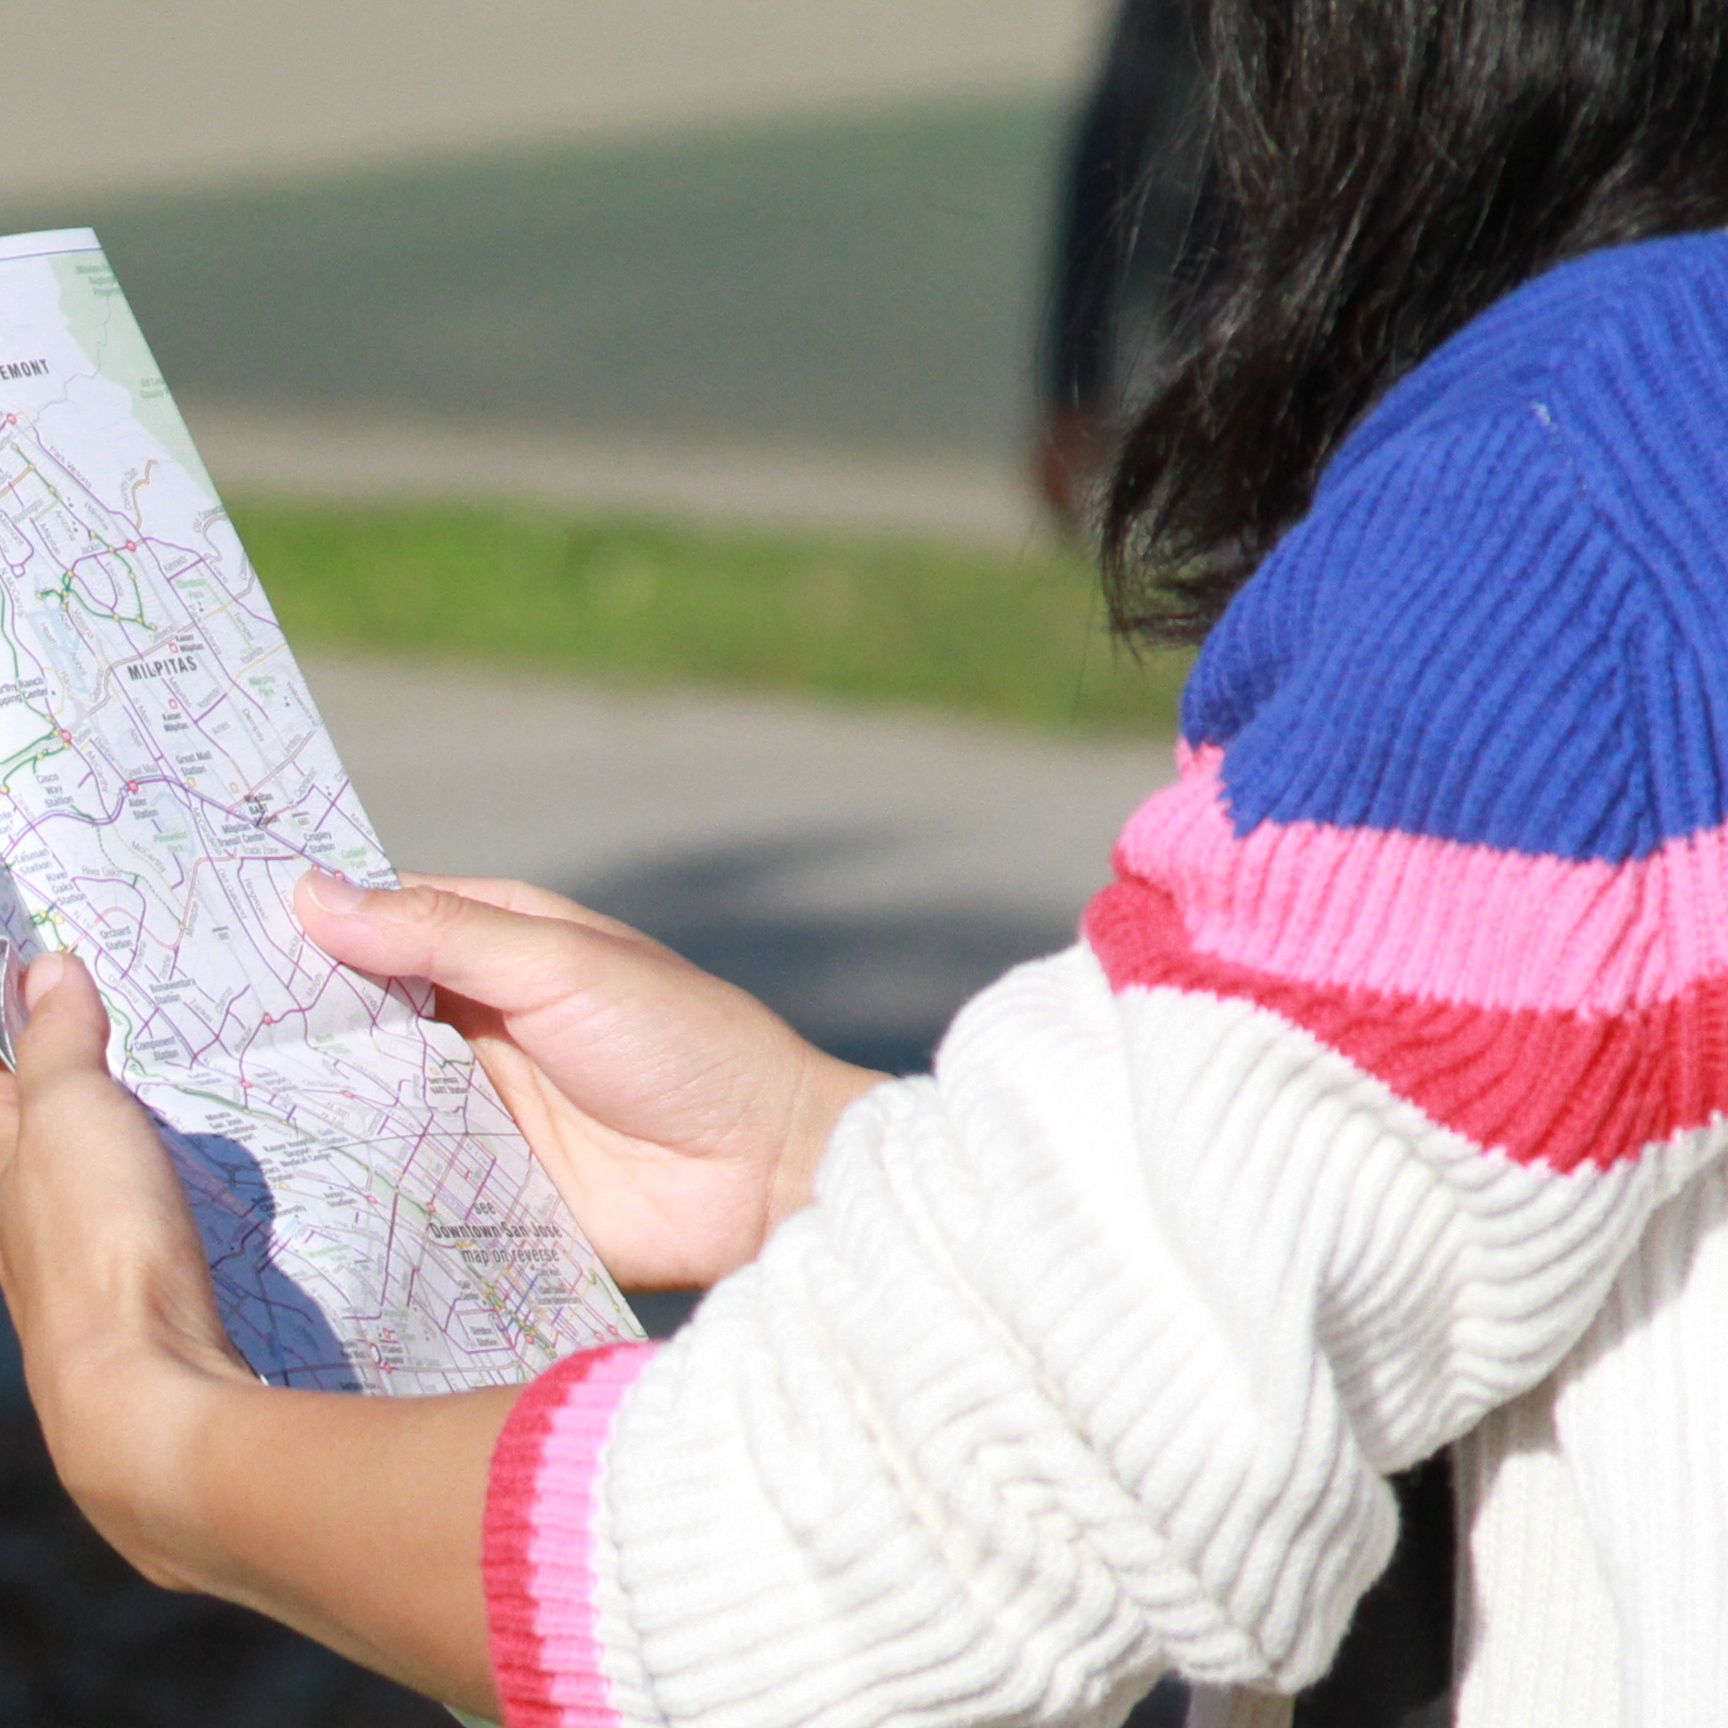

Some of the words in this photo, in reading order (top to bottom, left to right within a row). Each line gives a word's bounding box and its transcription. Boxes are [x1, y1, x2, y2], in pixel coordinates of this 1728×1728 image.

[126, 656, 197, 680] MILPITAS
[22, 688, 48, 700] Center
[44, 796, 73, 808] Station
[14, 849, 50, 864] Tasman
[19, 860, 52, 876] Station
[57, 893, 87, 906] Station
[100, 926, 132, 939] Orchard
[104, 940, 134, 951] Station
[474, 1201, 496, 1216] see
[428, 1222, 501, 1239] Downtown
[501, 1222, 529, 1238] San
[461, 1248, 490, 1266] map
[492, 1248, 510, 1262] on
[511, 1247, 561, 1263] reverse
